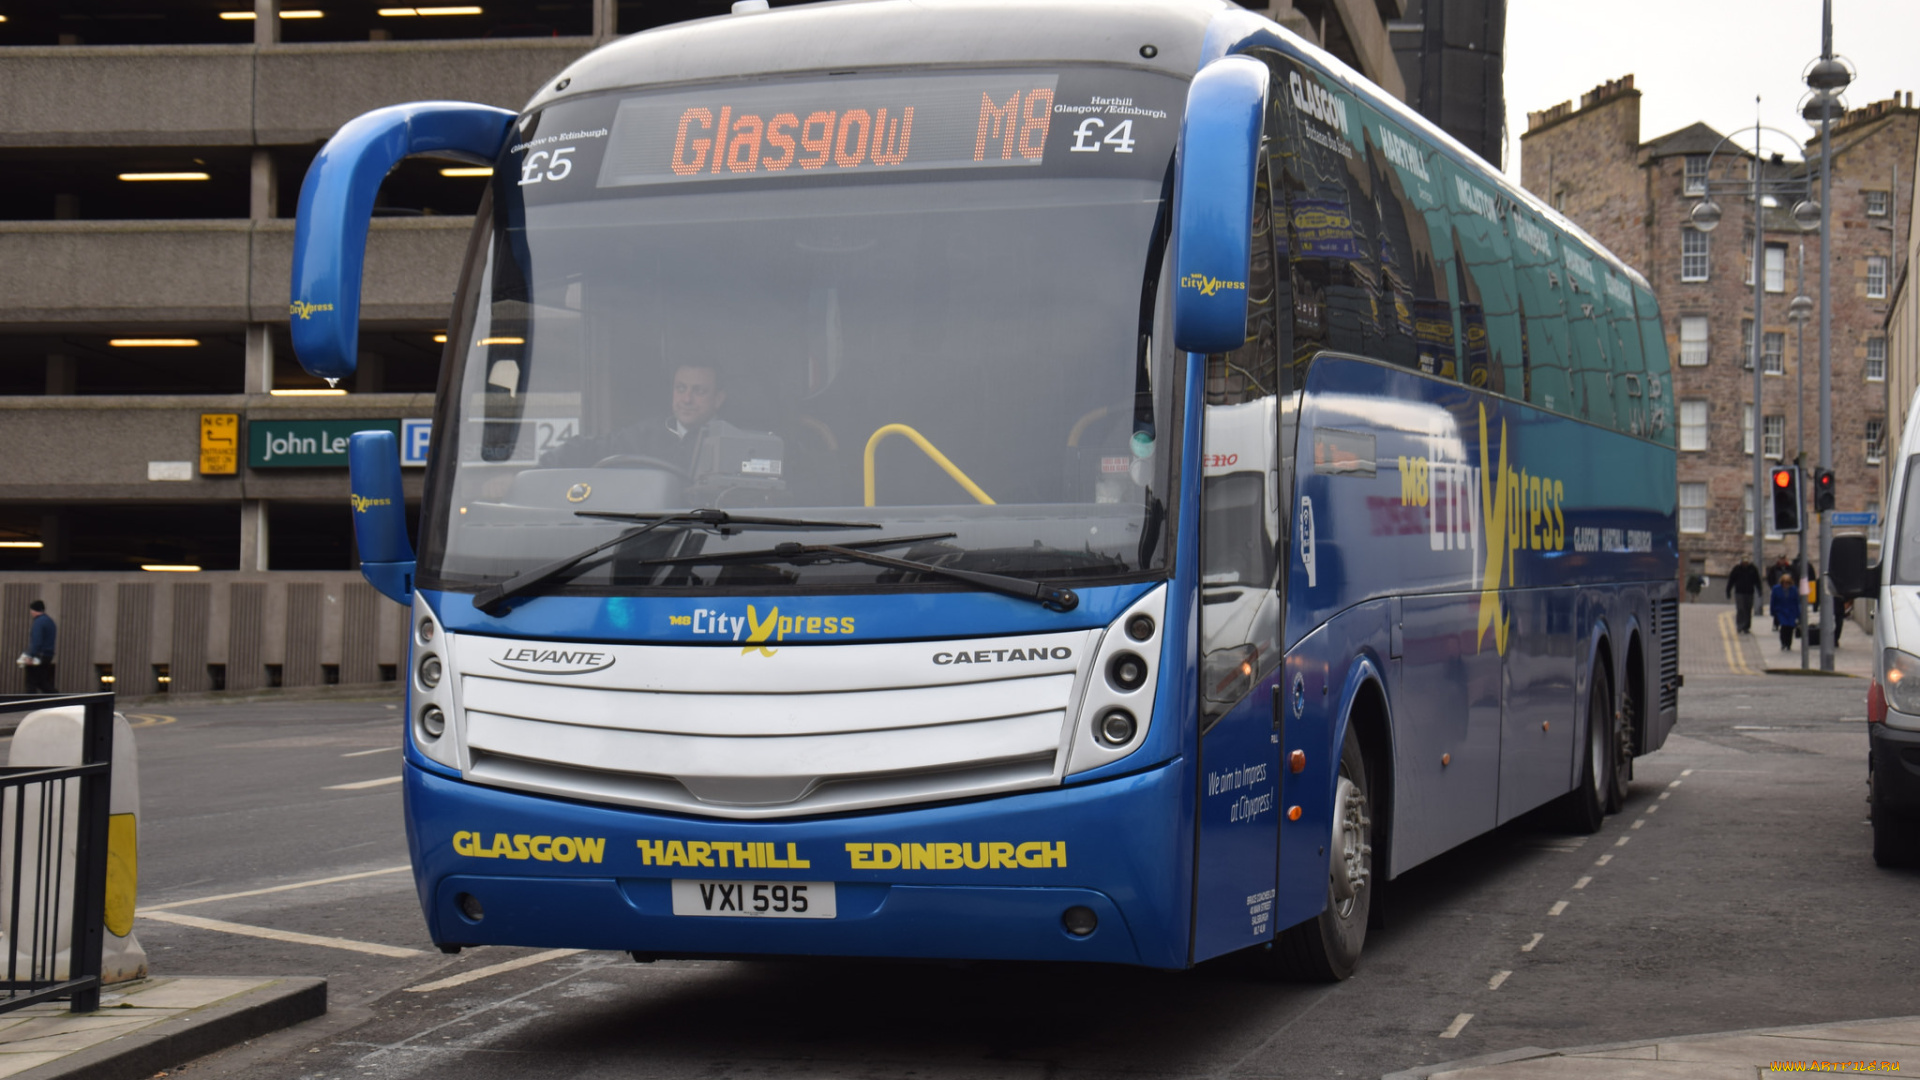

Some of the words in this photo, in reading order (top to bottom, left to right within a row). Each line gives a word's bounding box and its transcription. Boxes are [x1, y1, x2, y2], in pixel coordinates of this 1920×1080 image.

[1054, 104, 1102, 114] Glasgow
[1091, 96, 1133, 106] Harthill
[1289, 70, 1349, 135] GLASGOW
[510, 136, 547, 154] Glasgow
[548, 134, 558, 143] to
[559, 128, 608, 142] Edinburgh
[671, 105, 915, 176] Glasgow
[974, 88, 1054, 162] M8
[1070, 117, 1135, 153] £4
[517, 147, 576, 186] £5
[1378, 124, 1430, 183] HARTHILL
[1181, 276, 1245, 296] CityXpress
[263, 431, 317, 461] John
[1399, 456, 1429, 507] M8
[669, 615, 692, 626] M8
[692, 604, 855, 658] CityXpress
[503, 648, 605, 666] LEVANTE
[932, 646, 1072, 666] CAETANO
[1208, 771, 1219, 796] We
[1220, 767, 1233, 793] aim
[1234, 767, 1242, 789] to
[1242, 763, 1266, 791] Impress
[1230, 800, 1239, 823] at
[452, 831, 605, 863] GLASGOW
[637, 839, 810, 869] HARTHILL
[845, 841, 1067, 870] EDINBURGH
[753, 885, 808, 913] 595
